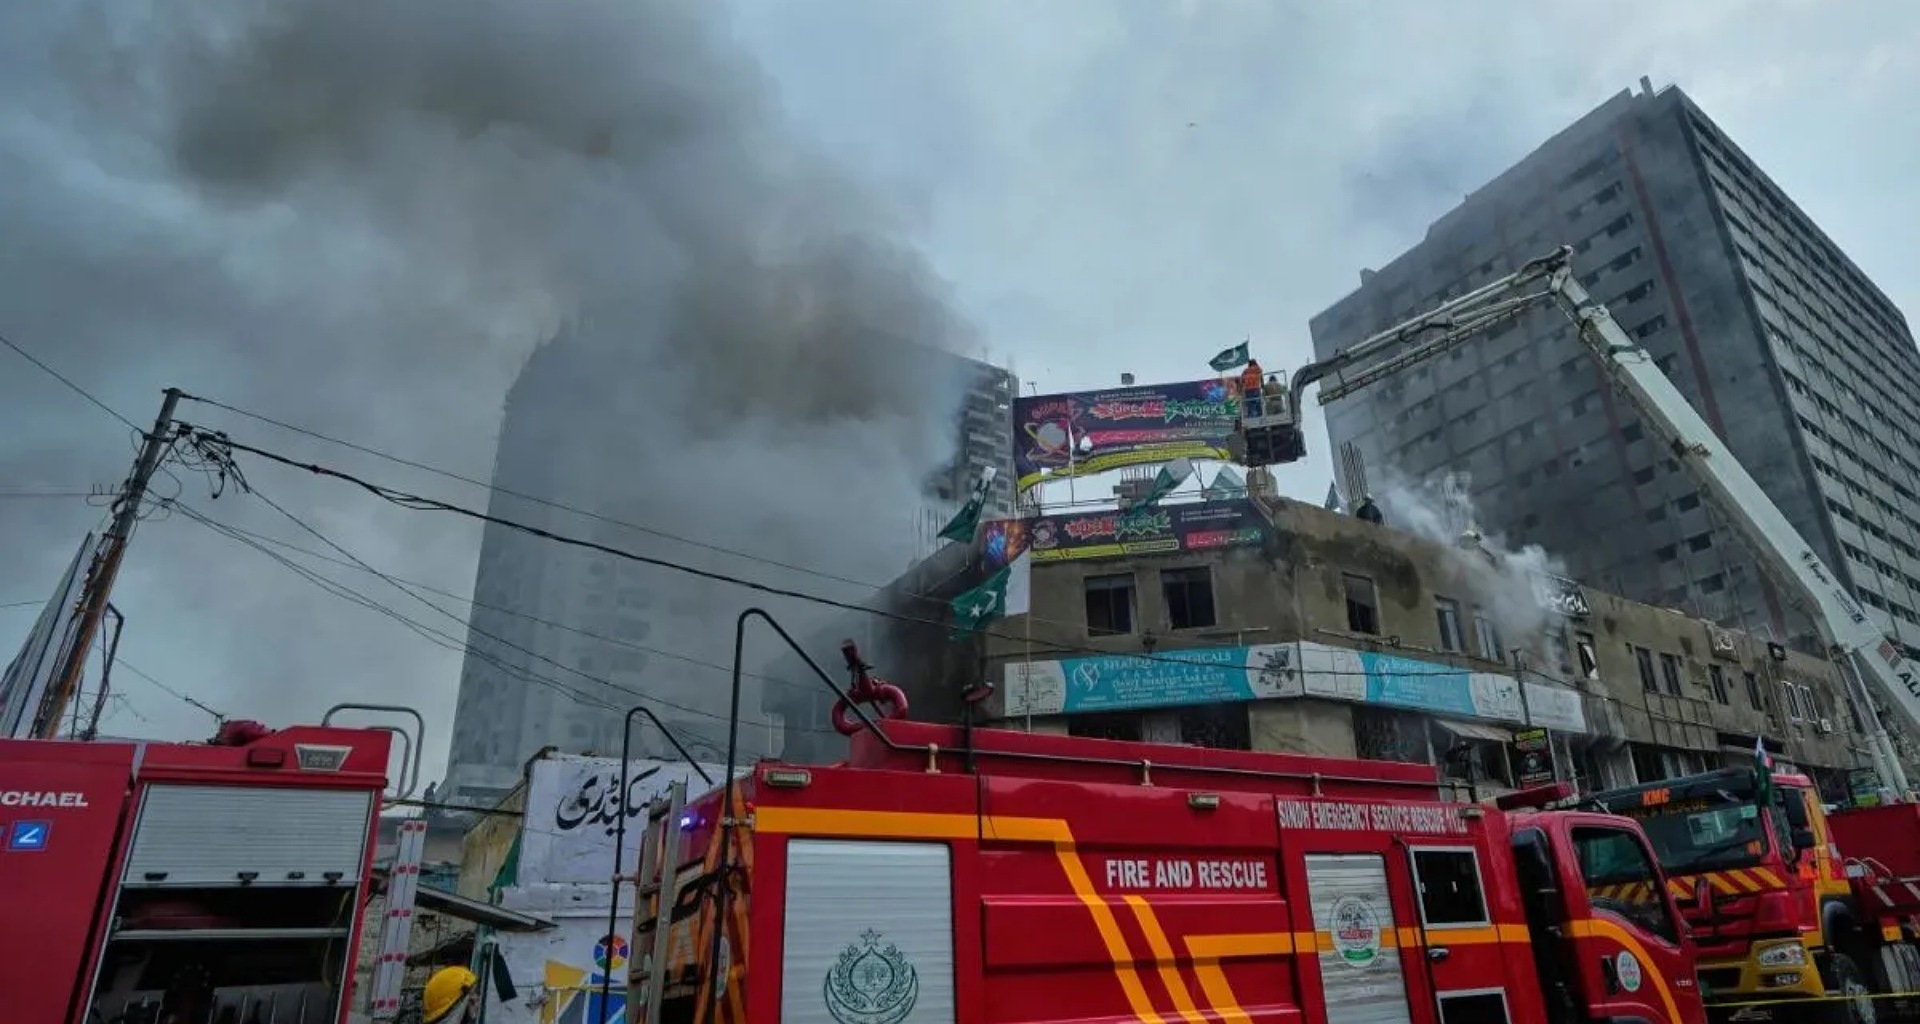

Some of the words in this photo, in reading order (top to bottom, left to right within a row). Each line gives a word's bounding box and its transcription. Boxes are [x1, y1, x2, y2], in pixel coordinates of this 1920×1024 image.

[1642, 787, 1670, 806] KMC
[1277, 799, 1311, 829] SINDH
[1311, 800, 1370, 831] EMERGENCY
[1371, 803, 1411, 832] SERVICE
[1411, 805, 1447, 834] RESCUE
[1106, 859, 1151, 888] FIRE
[1155, 860, 1194, 888] AND
[1198, 861, 1268, 889] RESCUE
